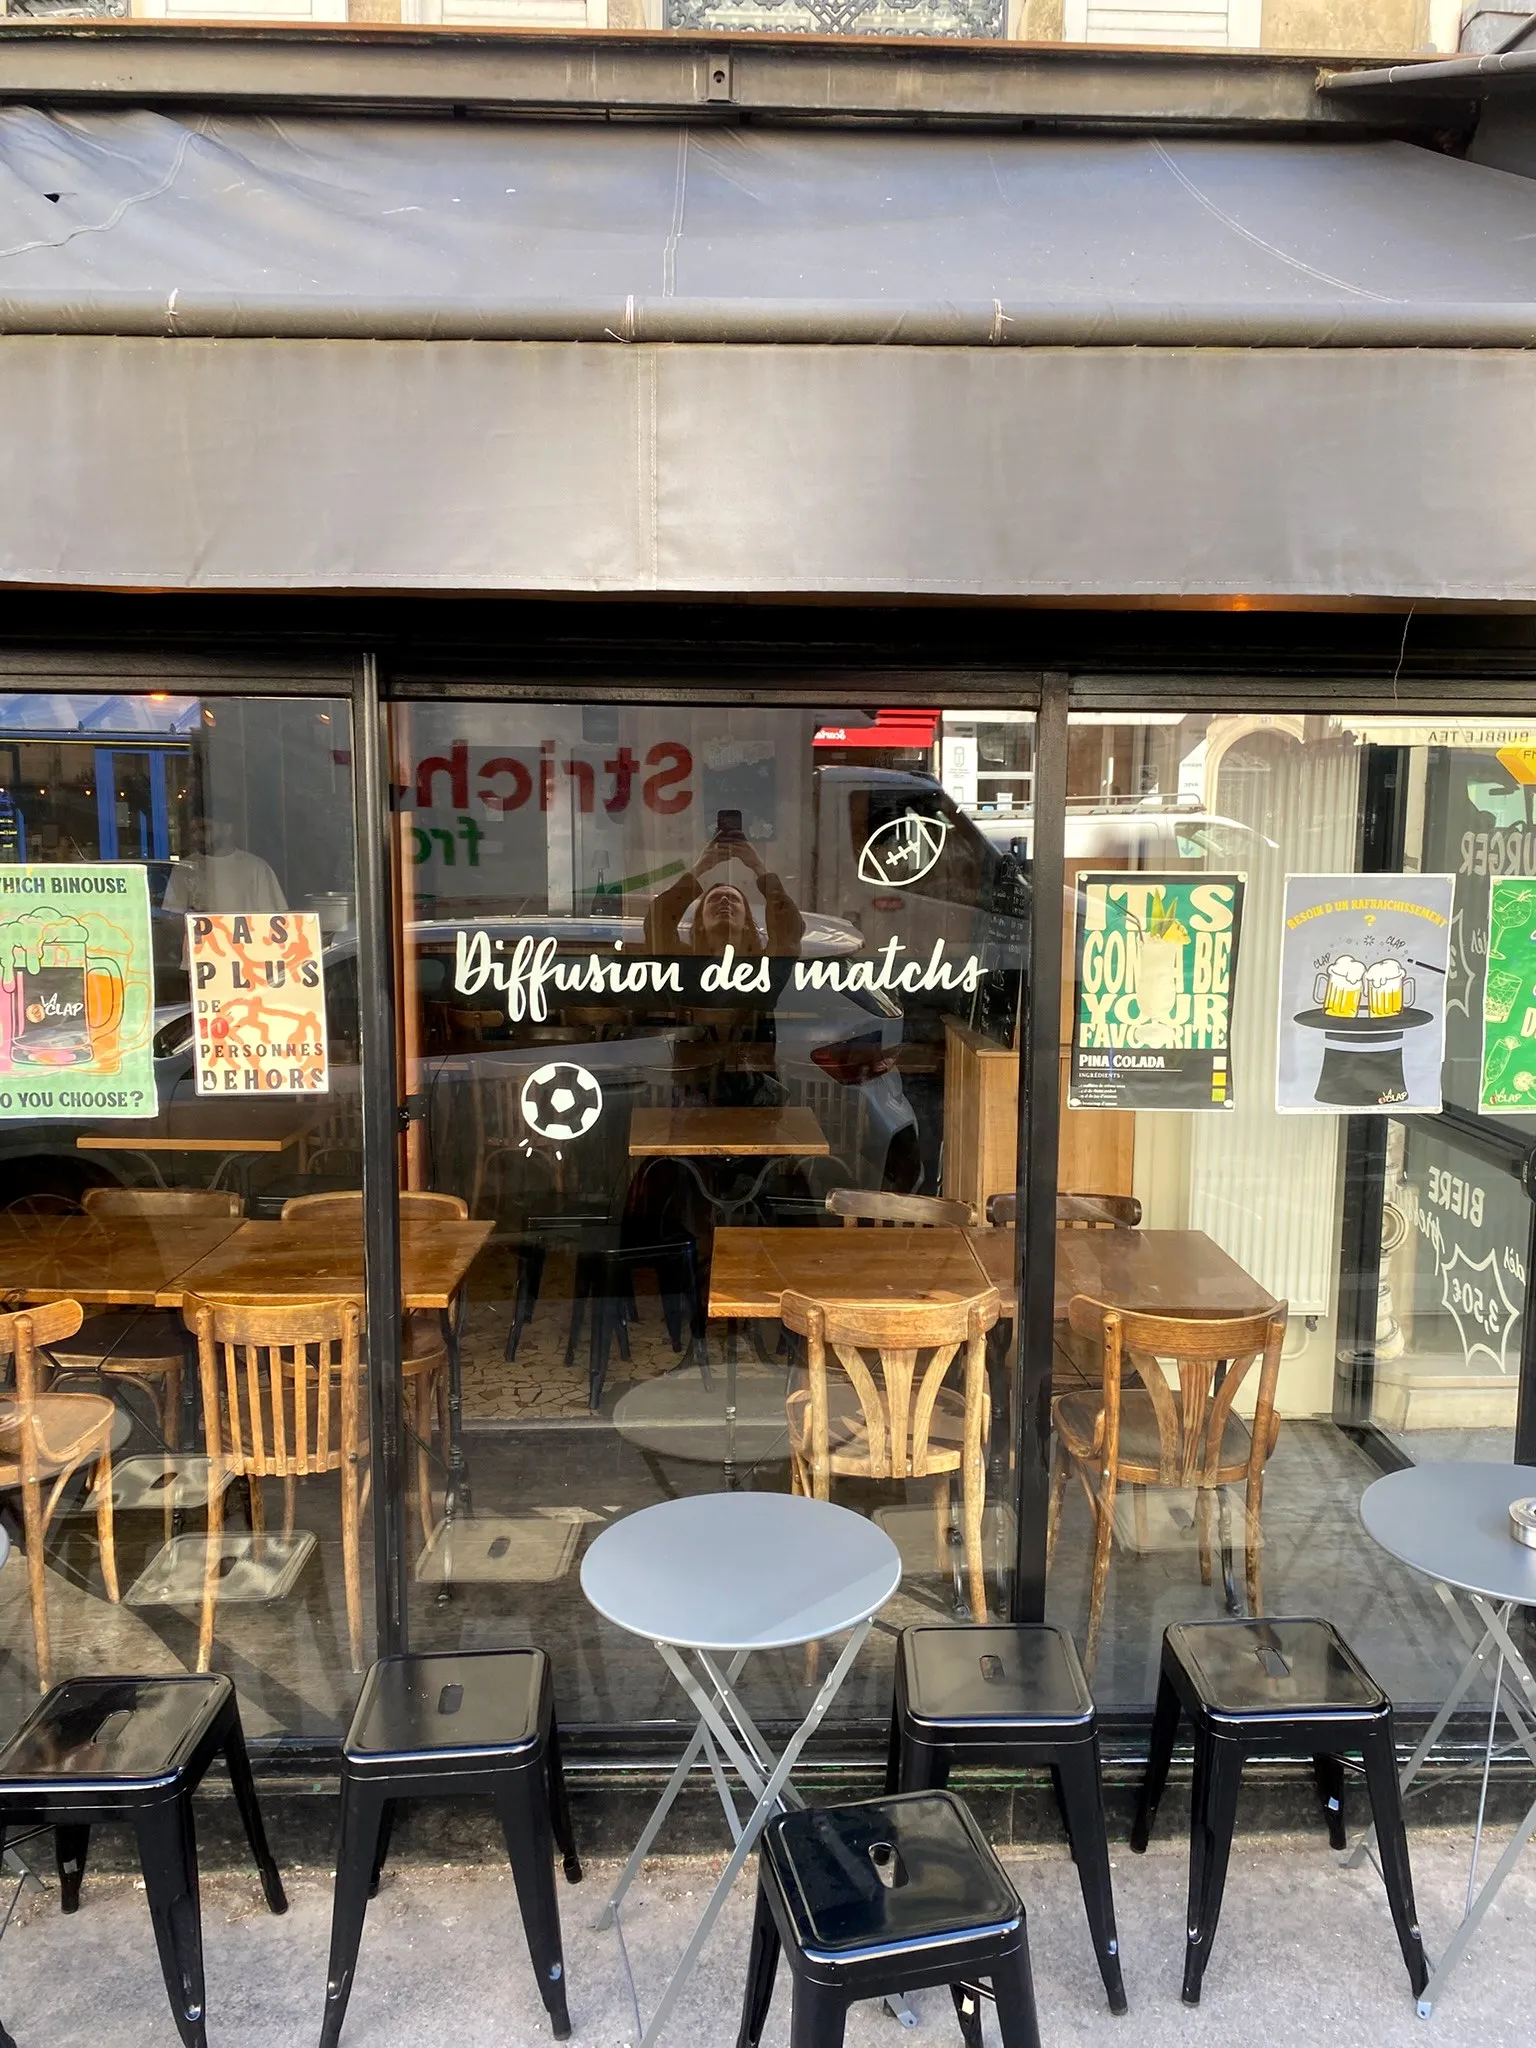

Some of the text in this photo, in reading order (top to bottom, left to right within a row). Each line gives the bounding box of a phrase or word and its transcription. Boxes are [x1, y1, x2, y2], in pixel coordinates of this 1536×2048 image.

[0, 877, 127, 894] HICH BINOUSE
[1287, 905, 1324, 930] BESOIN
[1335, 901, 1349, 912] UN
[1351, 899, 1448, 929] RAFRAICHISSEMENT
[1364, 914, 1376, 927] ?
[194, 915, 289, 945] PAS
[1386, 935, 1407, 949] CLAP
[1082, 930, 1185, 994] GONA
[1192, 931, 1232, 994] BE
[1313, 952, 1332, 969] CLAP
[195, 959, 320, 990] PLUS
[454, 930, 683, 1023] Diffusion
[700, 944, 771, 994] des
[795, 935, 990, 994] matchs
[40, 992, 59, 1009] LA
[45, 1002, 84, 1016] CLAP
[198, 1000, 221, 1014] DE
[1081, 993, 1229, 1030] YOUR
[198, 1016, 230, 1040] 10
[1079, 1023, 1228, 1050] FAVORITE
[200, 1042, 324, 1059] PERSONNES
[1079, 1054, 1165, 1069] PINA COLADA
[202, 1068, 325, 1091] DEHORS
[0, 1090, 144, 1108] O YOU CHOOSE?
[1386, 1091, 1408, 1103] CLAP
[1497, 1093, 1522, 1103] CLAP
